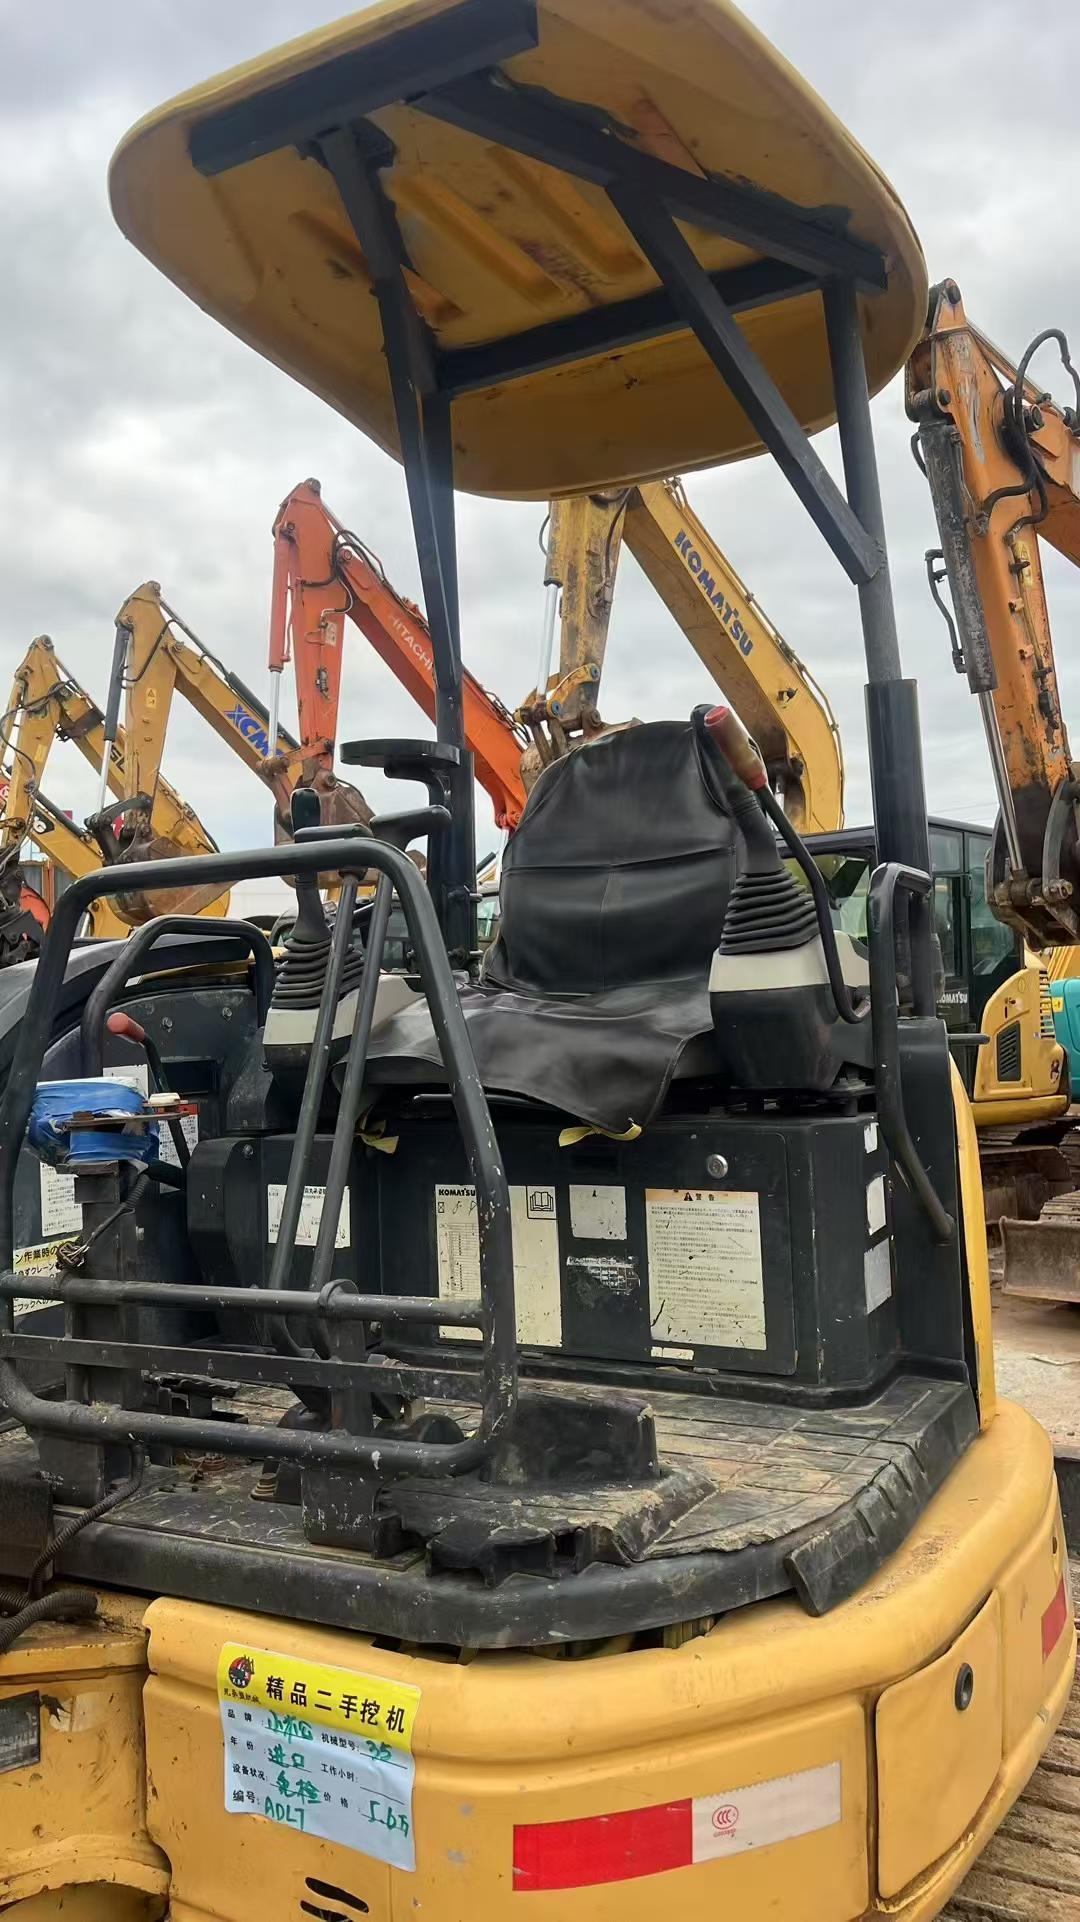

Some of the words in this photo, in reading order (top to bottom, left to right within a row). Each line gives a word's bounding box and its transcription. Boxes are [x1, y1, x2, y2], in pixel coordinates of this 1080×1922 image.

[674, 528, 753, 656] KOMATSU
[223, 703, 285, 757] XCM
[936, 991, 968, 1004] OMATSU
[438, 1187, 476, 1197] KOMATSU
[266, 1675, 405, 1733] 精品二手挖机
[267, 1743, 305, 1768] 进口
[365, 1739, 393, 1761] 35
